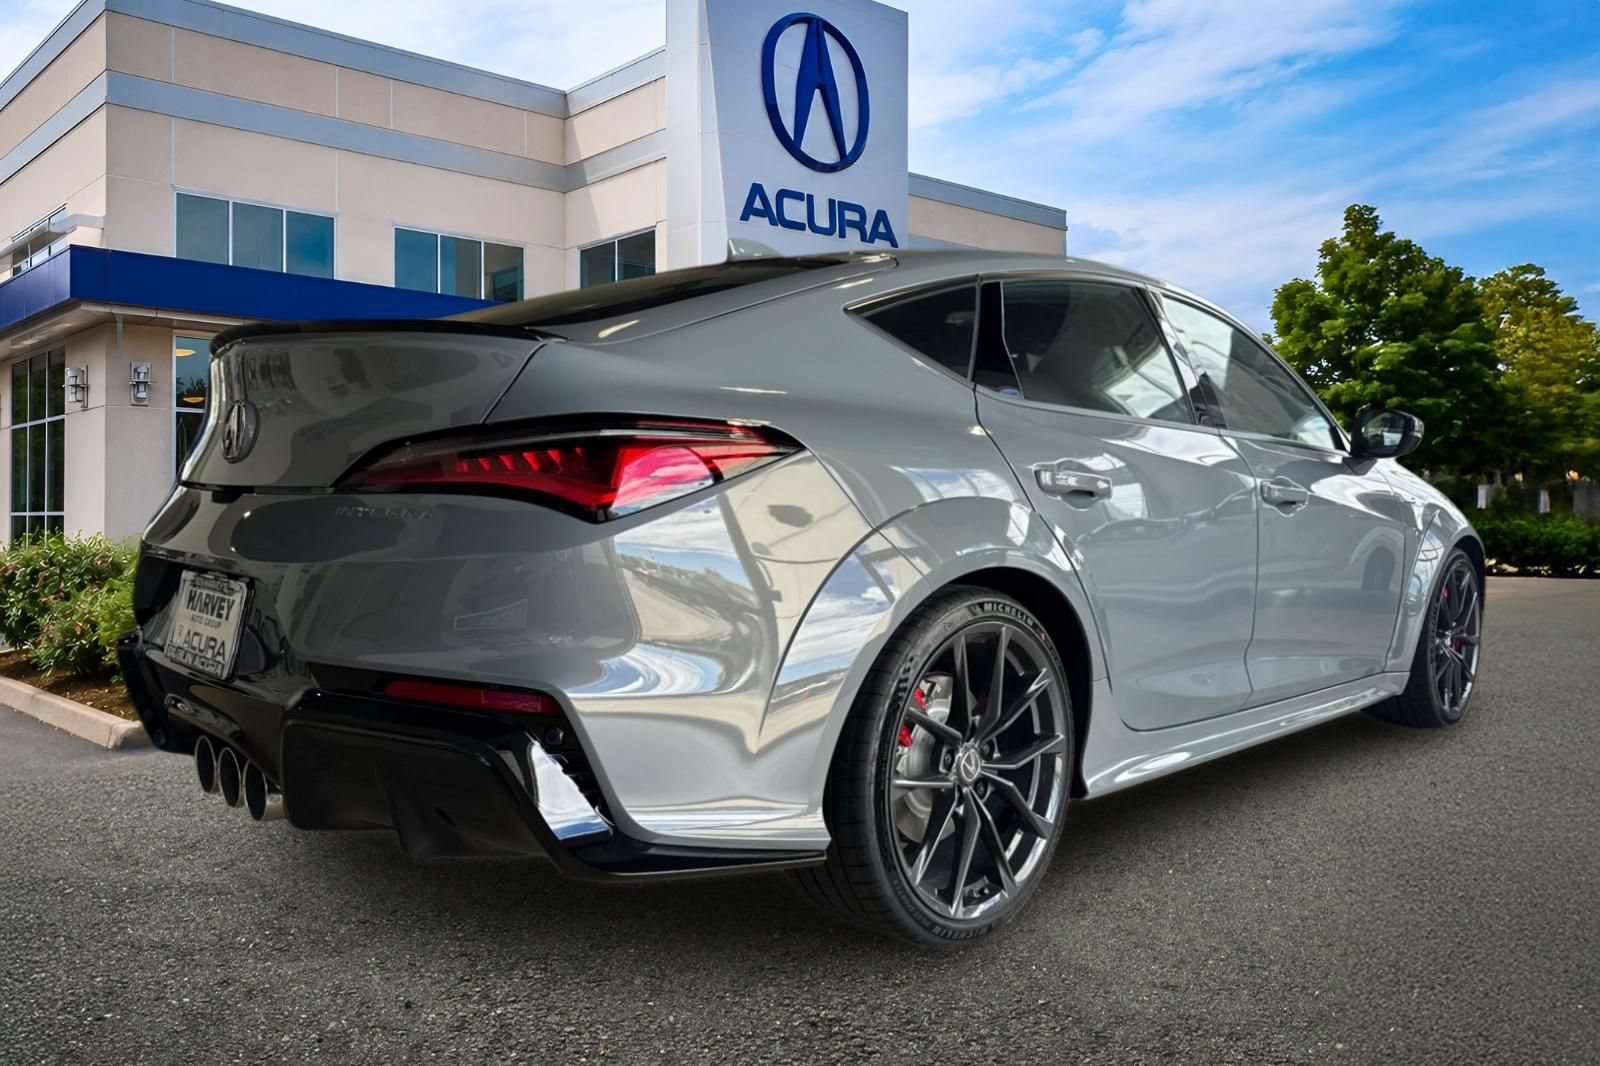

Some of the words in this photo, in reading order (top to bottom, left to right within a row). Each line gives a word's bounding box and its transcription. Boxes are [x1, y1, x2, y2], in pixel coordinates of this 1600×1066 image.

[740, 182, 898, 248] ACURA
[187, 588, 235, 621] HARVEY
[983, 602, 1034, 627] MICHELIN
[183, 629, 226, 661] ACURA
